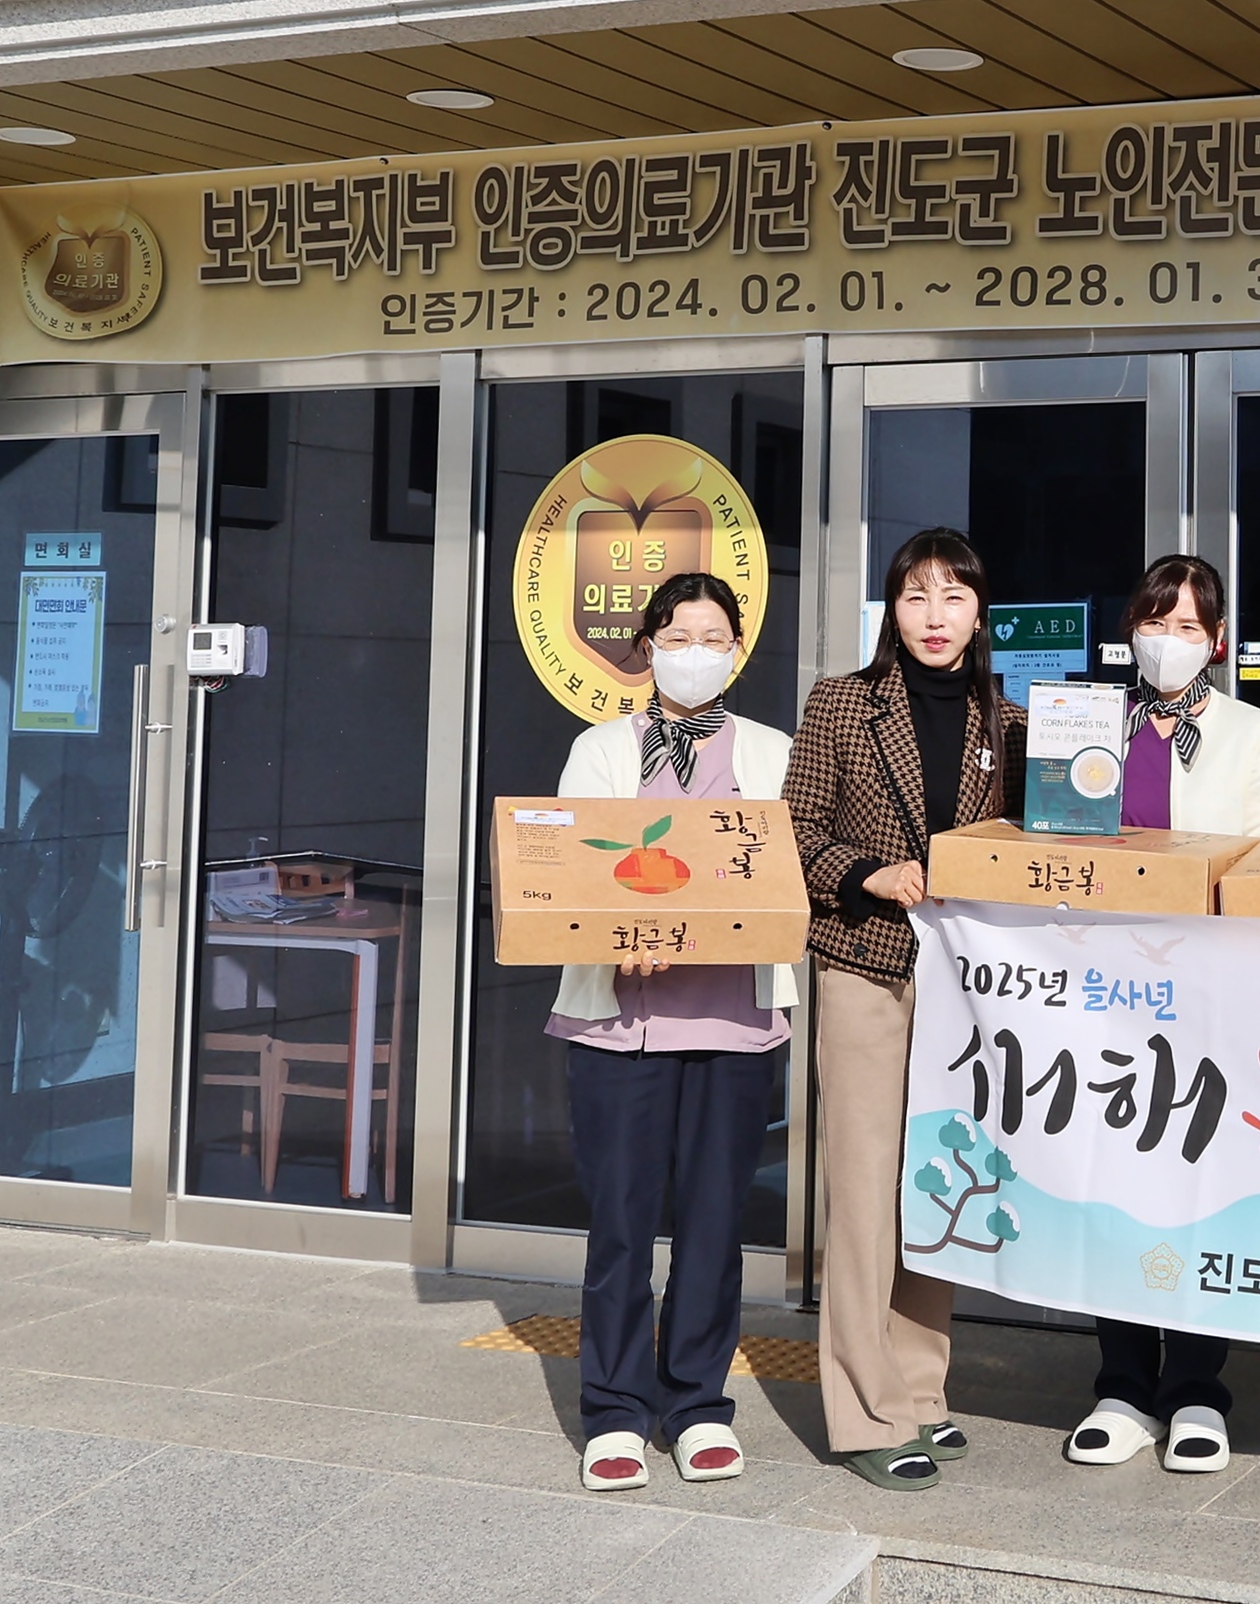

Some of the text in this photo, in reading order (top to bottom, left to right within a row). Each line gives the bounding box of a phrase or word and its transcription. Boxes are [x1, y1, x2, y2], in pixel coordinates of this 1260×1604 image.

[201, 169, 455, 284] 보건복지부
[473, 141, 815, 269] 인증의료기관
[832, 132, 1017, 250] 진도군
[75, 253, 105, 269] 인증
[131, 228, 152, 277] PATIENT
[53, 273, 119, 289] 의료기관
[380, 285, 539, 335] 인증기간
[556, 291, 567, 318] :
[586, 277, 718, 321] 2024.
[741, 273, 816, 315] 02.
[840, 271, 904, 312] 01.
[975, 264, 1124, 307] 2028.
[1149, 262, 1222, 303] 01.
[34, 541, 92, 558] 면회실
[712, 494, 750, 581] PATIENT
[609, 540, 666, 572] 인증
[527, 494, 568, 676] HEALTHCARE QUALITY
[1034, 619, 1076, 634] AED
[1041, 718, 1111, 729] CORN FLAKES TEA
[709, 810, 767, 879] 황금봉
[522, 891, 552, 901] 5kg
[1027, 861, 1094, 896] 황금봉
[612, 922, 687, 952] 황금봉
[957, 956, 1177, 1021] 2025년 을사년
[949, 1025, 1228, 1165] 새해
